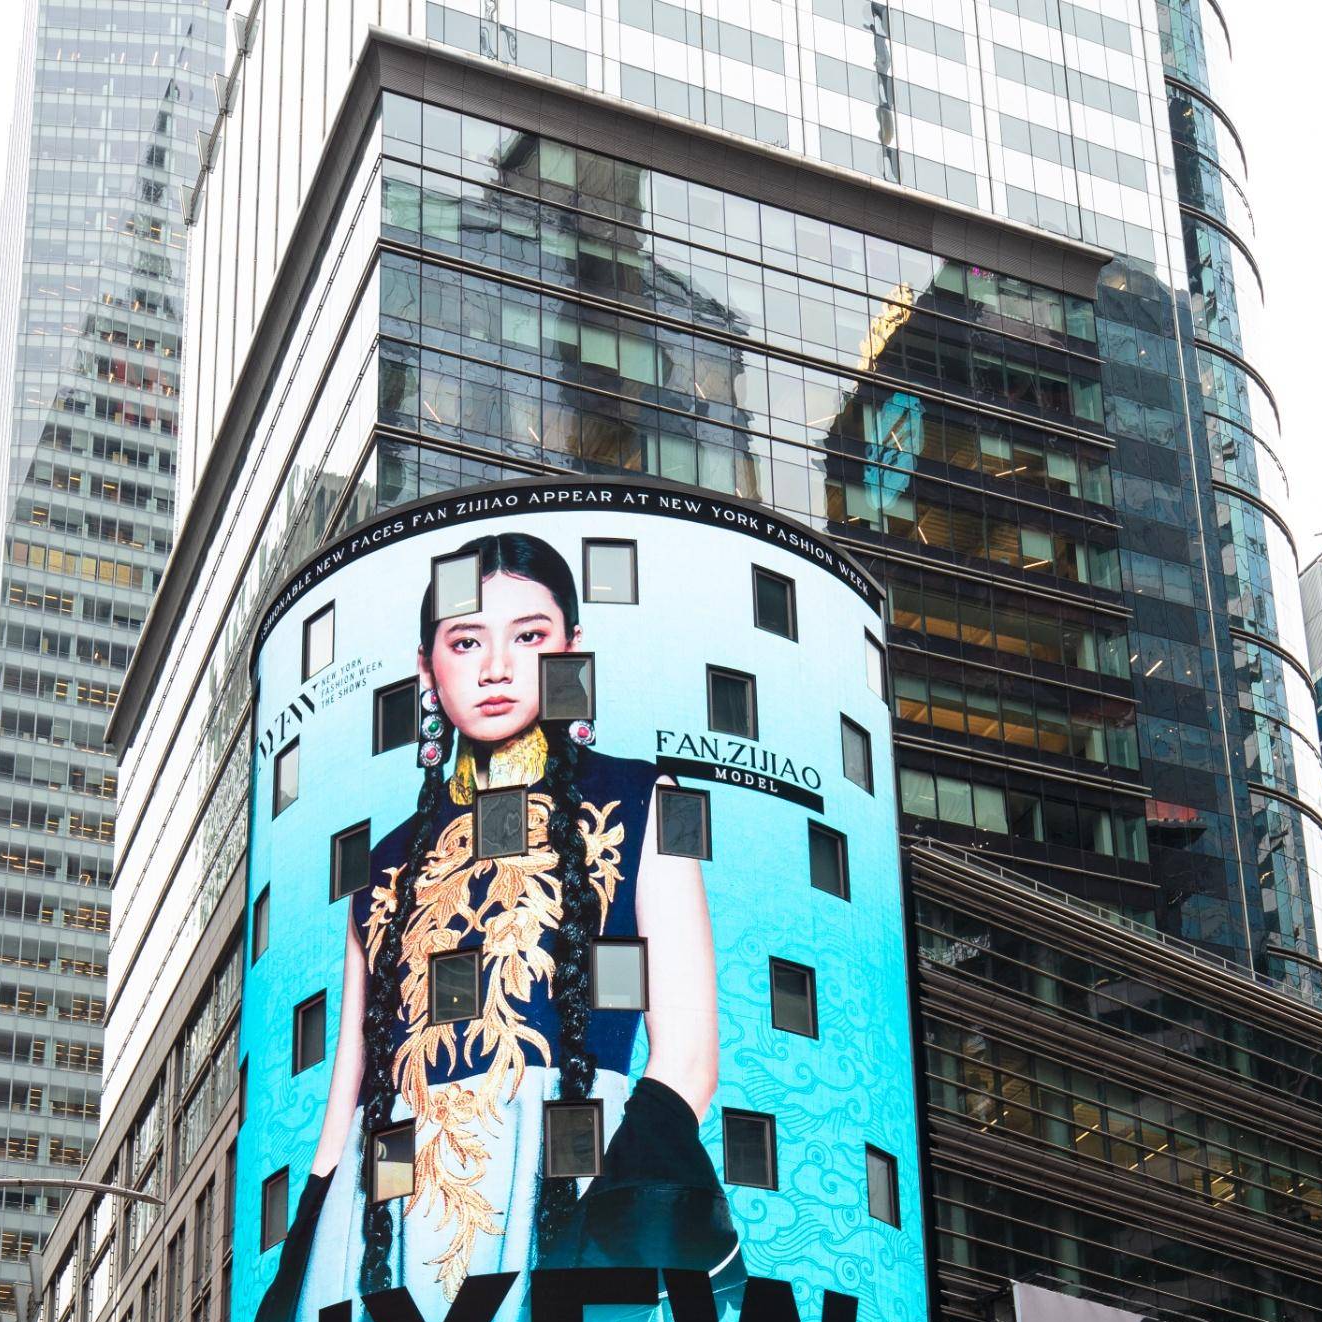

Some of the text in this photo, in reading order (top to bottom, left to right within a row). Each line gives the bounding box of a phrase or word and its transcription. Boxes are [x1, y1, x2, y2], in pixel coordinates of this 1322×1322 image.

[316, 550, 345, 573] NEW
[351, 522, 404, 553] FACES
[412, 507, 447, 528] FAN
[456, 495, 518, 515] ZIJIAO
[528, 490, 612, 504] APPEAR
[623, 492, 649, 505] AT
[659, 496, 701, 513] NEW
[711, 506, 759, 530] YORK
[767, 524, 833, 566] FASHION
[838, 560, 869, 596] WEEK
[321, 657, 362, 686] NEW YORK
[321, 660, 383, 697] FASHION WEEK
[321, 678, 367, 709] THE SHOWS
[715, 767, 778, 793] MODEL
